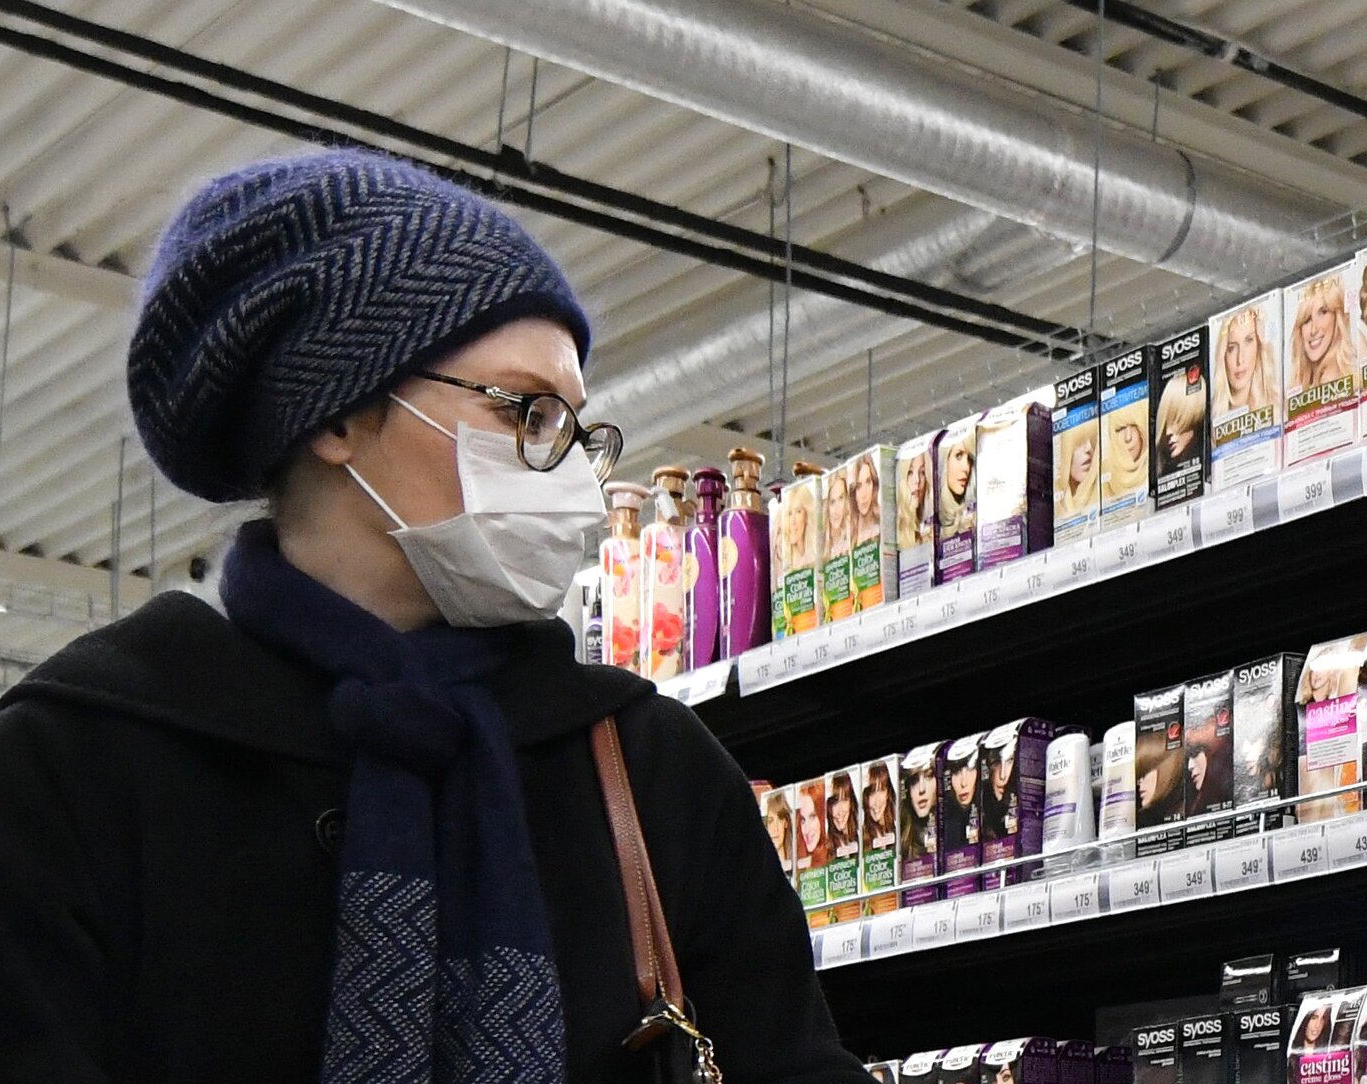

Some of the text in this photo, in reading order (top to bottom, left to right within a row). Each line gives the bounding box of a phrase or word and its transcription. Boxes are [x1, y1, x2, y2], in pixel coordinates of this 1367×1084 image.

[1161, 333, 1200, 360] syoss
[1106, 351, 1142, 377] syoss
[1057, 373, 1093, 398] syoss
[1289, 377, 1351, 411] EXCELLENCE
[1215, 408, 1272, 439] EXCELLENCE
[1305, 484, 1322, 500] 399
[1227, 508, 1243, 525] 399
[1168, 527, 1183, 544] 349
[1118, 543, 1134, 560] 349
[1072, 560, 1088, 576] 349
[1239, 659, 1277, 685] syoss
[1190, 676, 1230, 699] syoss
[1301, 848, 1319, 864] 439
[834, 868, 852, 882] Color
[869, 860, 888, 873] Color
[1242, 858, 1259, 875] 349
[1186, 869, 1203, 887] 349
[1134, 879, 1150, 896] 349
[1074, 891, 1090, 908] 175
[1027, 902, 1042, 917] 175
[978, 911, 992, 926] 175
[890, 925, 904, 940] 175
[1240, 1011, 1281, 1032] syoss
[1138, 1029, 1175, 1049] syoss
[1183, 1020, 1222, 1041] syoss
[1300, 1054, 1350, 1077] casting
[1323, 1071, 1342, 1084] gloss
